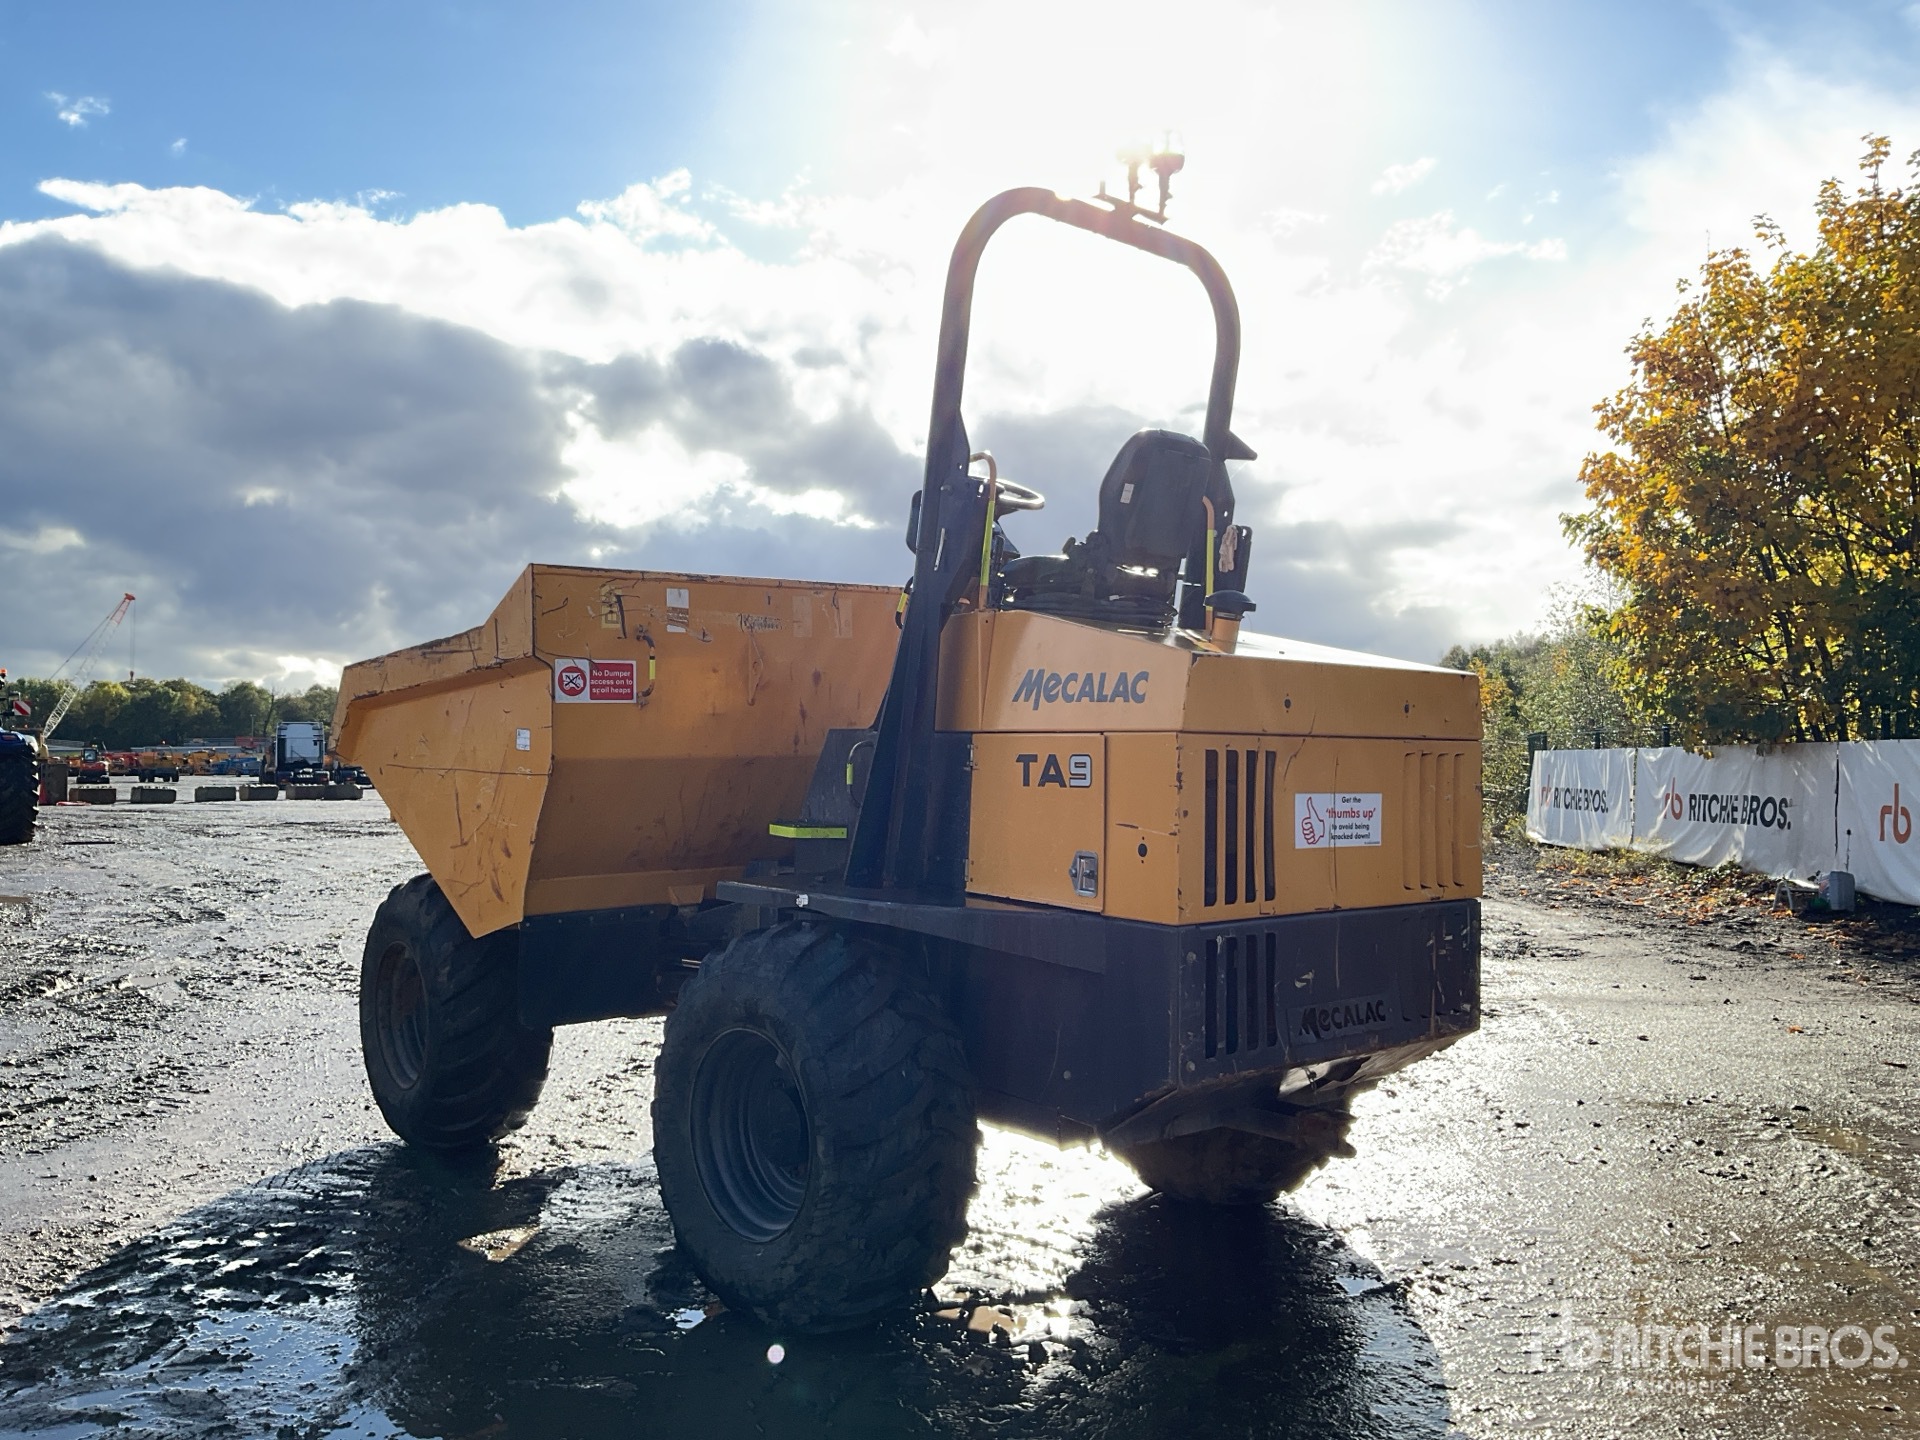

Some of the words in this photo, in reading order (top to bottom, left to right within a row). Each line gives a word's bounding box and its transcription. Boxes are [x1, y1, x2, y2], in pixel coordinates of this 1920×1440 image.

[1016, 754, 1092, 788] TA9
[1554, 787, 1582, 810] RITCHIE
[1689, 793, 1739, 824] RITCHIE
[1740, 795, 1791, 830] BROS.
[1879, 783, 1912, 844] rb
[1331, 832, 1353, 840] knocked
